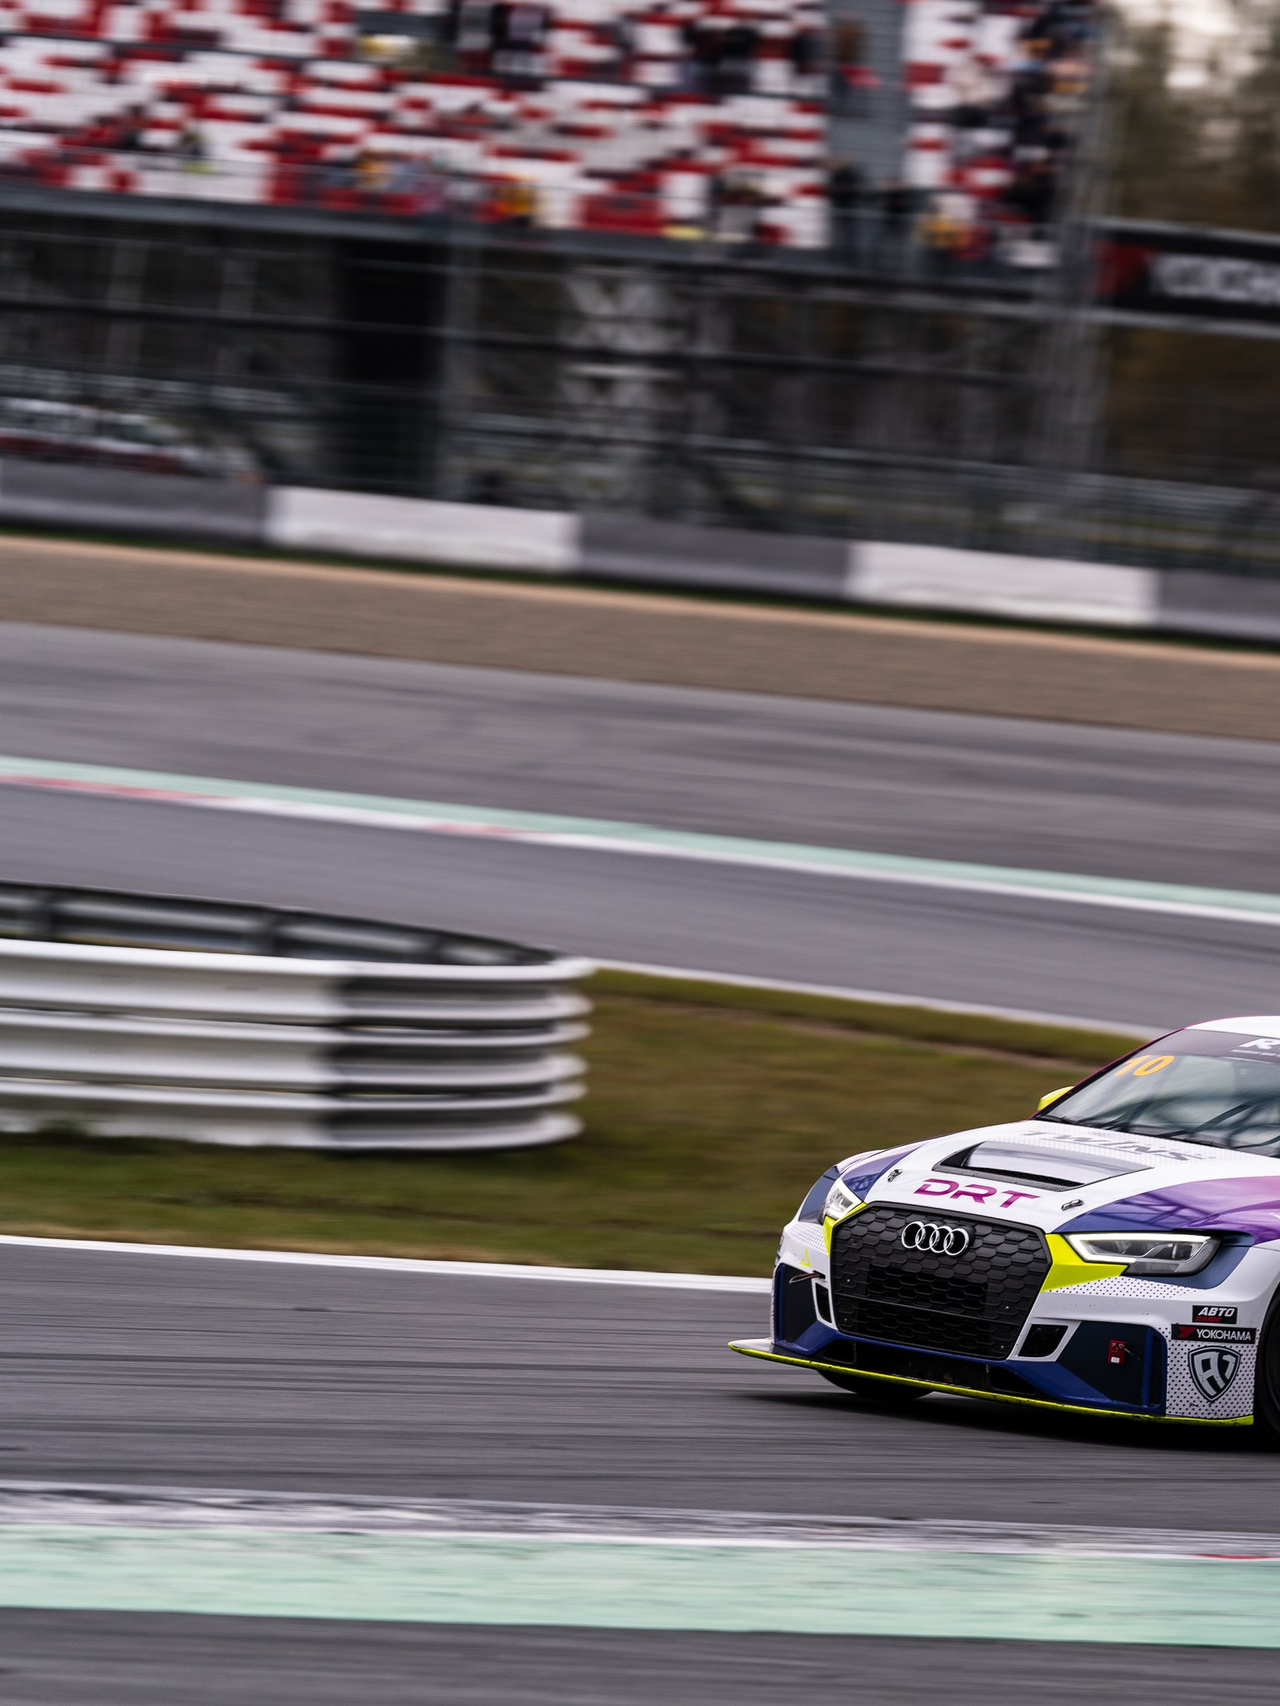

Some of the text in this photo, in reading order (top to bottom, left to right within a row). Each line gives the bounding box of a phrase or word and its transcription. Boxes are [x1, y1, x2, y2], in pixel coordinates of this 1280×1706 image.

[1114, 1055, 1176, 1077] 10
[913, 1178, 1042, 1208] DRT
[1198, 1307, 1236, 1317] АВТО
[1196, 1328, 1252, 1341] YOKOHAMA
